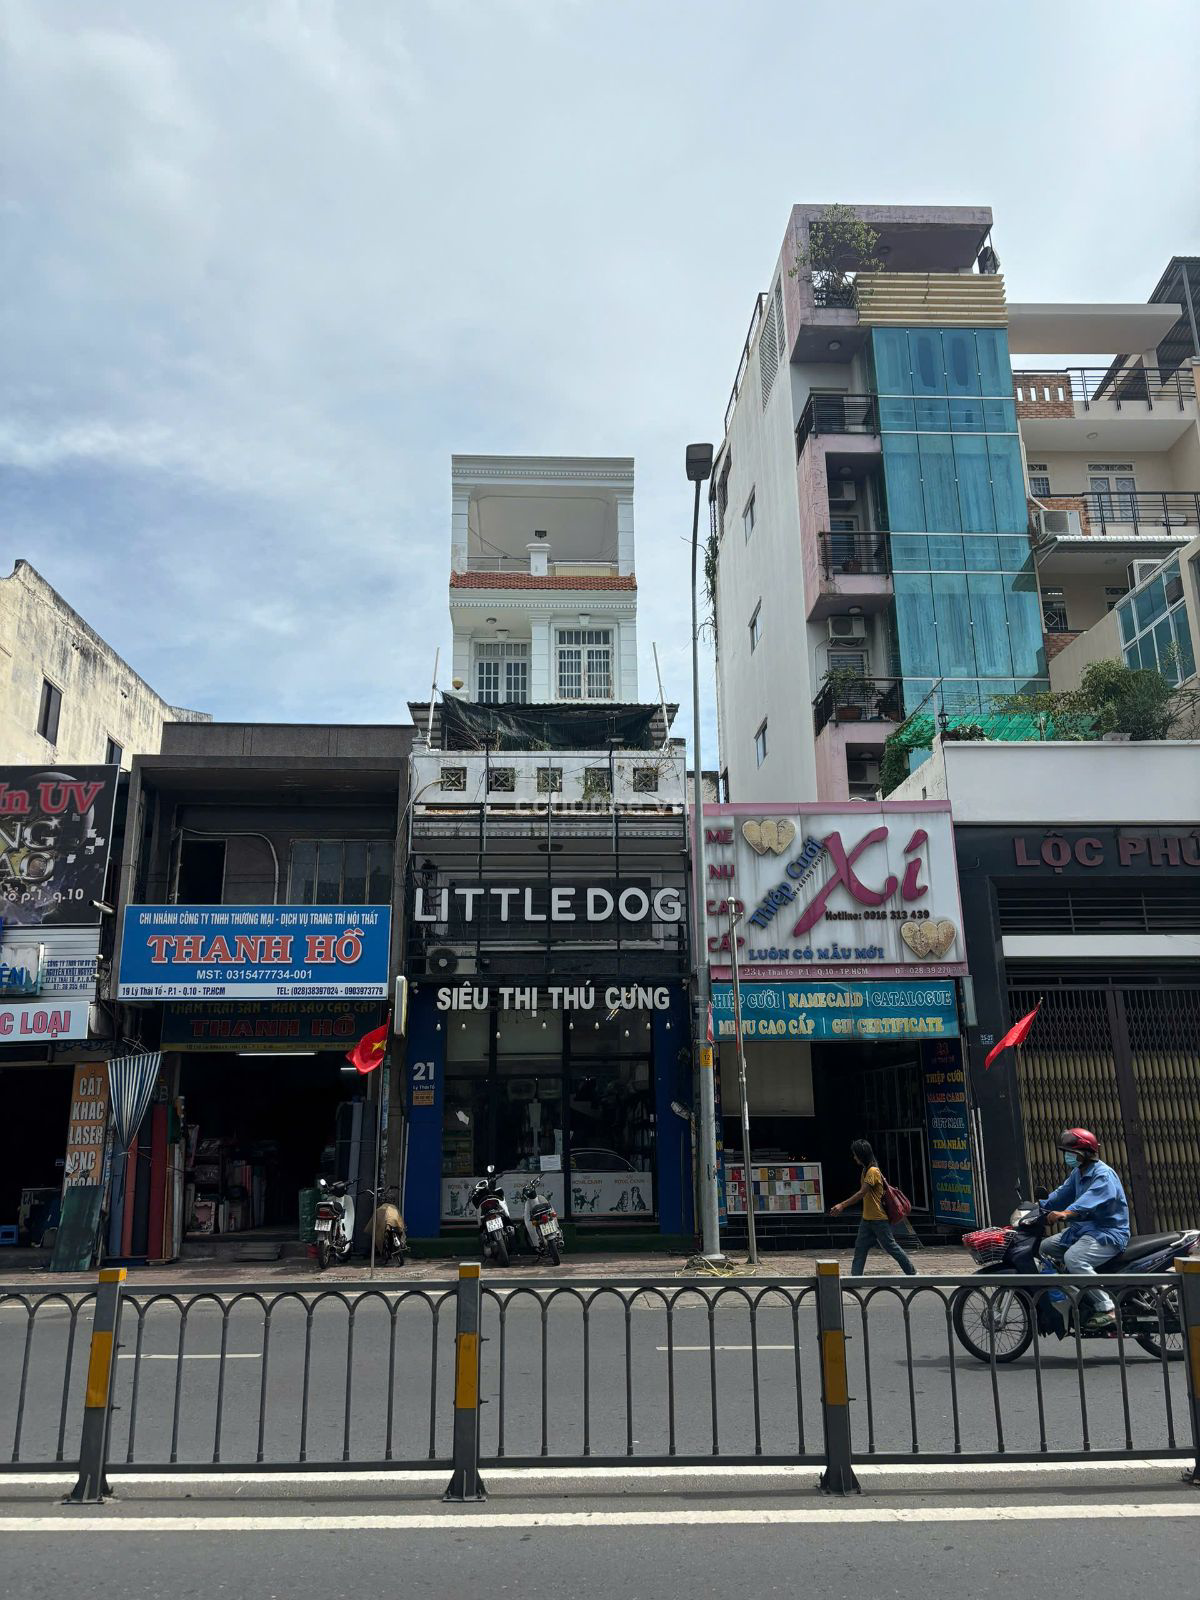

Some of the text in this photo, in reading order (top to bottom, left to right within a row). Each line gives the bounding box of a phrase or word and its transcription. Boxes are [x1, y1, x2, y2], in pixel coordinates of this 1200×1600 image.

[37, 781, 106, 814] UV
[705, 829, 734, 845] ME
[1013, 830, 1105, 874] LỘC
[709, 864, 735, 880] NU
[415, 887, 682, 922] LITTLE DOG
[706, 900, 744, 916] CAO
[749, 882, 795, 929] Thiệp
[139, 912, 152, 925] CHI
[153, 911, 178, 925] NHÁNH
[180, 910, 199, 925] CÔNG
[201, 912, 209, 925] TY
[211, 912, 229, 925] TNHH
[231, 912, 259, 925] THƯƠNG
[260, 912, 274, 928] MẠI
[281, 912, 297, 927] DỊCH
[299, 912, 308, 928] VỤ
[310, 912, 333, 925] TRANG
[335, 910, 345, 925] TRÍ
[347, 911, 360, 927] NỘI
[362, 909, 378, 925] THẤT
[863, 910, 888, 920] 0916
[890, 910, 907, 920] 313
[147, 935, 294, 964] THANH
[749, 945, 790, 960] LUÔN
[792, 945, 814, 960] CÓ
[196, 969, 313, 980] MST: 0315477734-001
[122, 988, 131, 996] 19
[203, 987, 226, 996] TP.HCM
[276, 987, 290, 996] TEL:
[436, 980, 670, 1017] SIÊU THỊ THÚ CƯNG
[712, 989, 745, 1012] HIỆP
[788, 992, 863, 1008] NAMECARD
[871, 990, 952, 1007] CATALOGUE
[20, 1010, 72, 1038] LOẠI
[190, 1019, 300, 1037] THANH
[758, 1019, 786, 1035] CAO
[788, 1012, 816, 1035] CẤP
[857, 1016, 944, 1033] CERTIFICATE
[412, 1061, 435, 1081] 21
[69, 1125, 104, 1145] LASER
[72, 1151, 97, 1171] CNC
